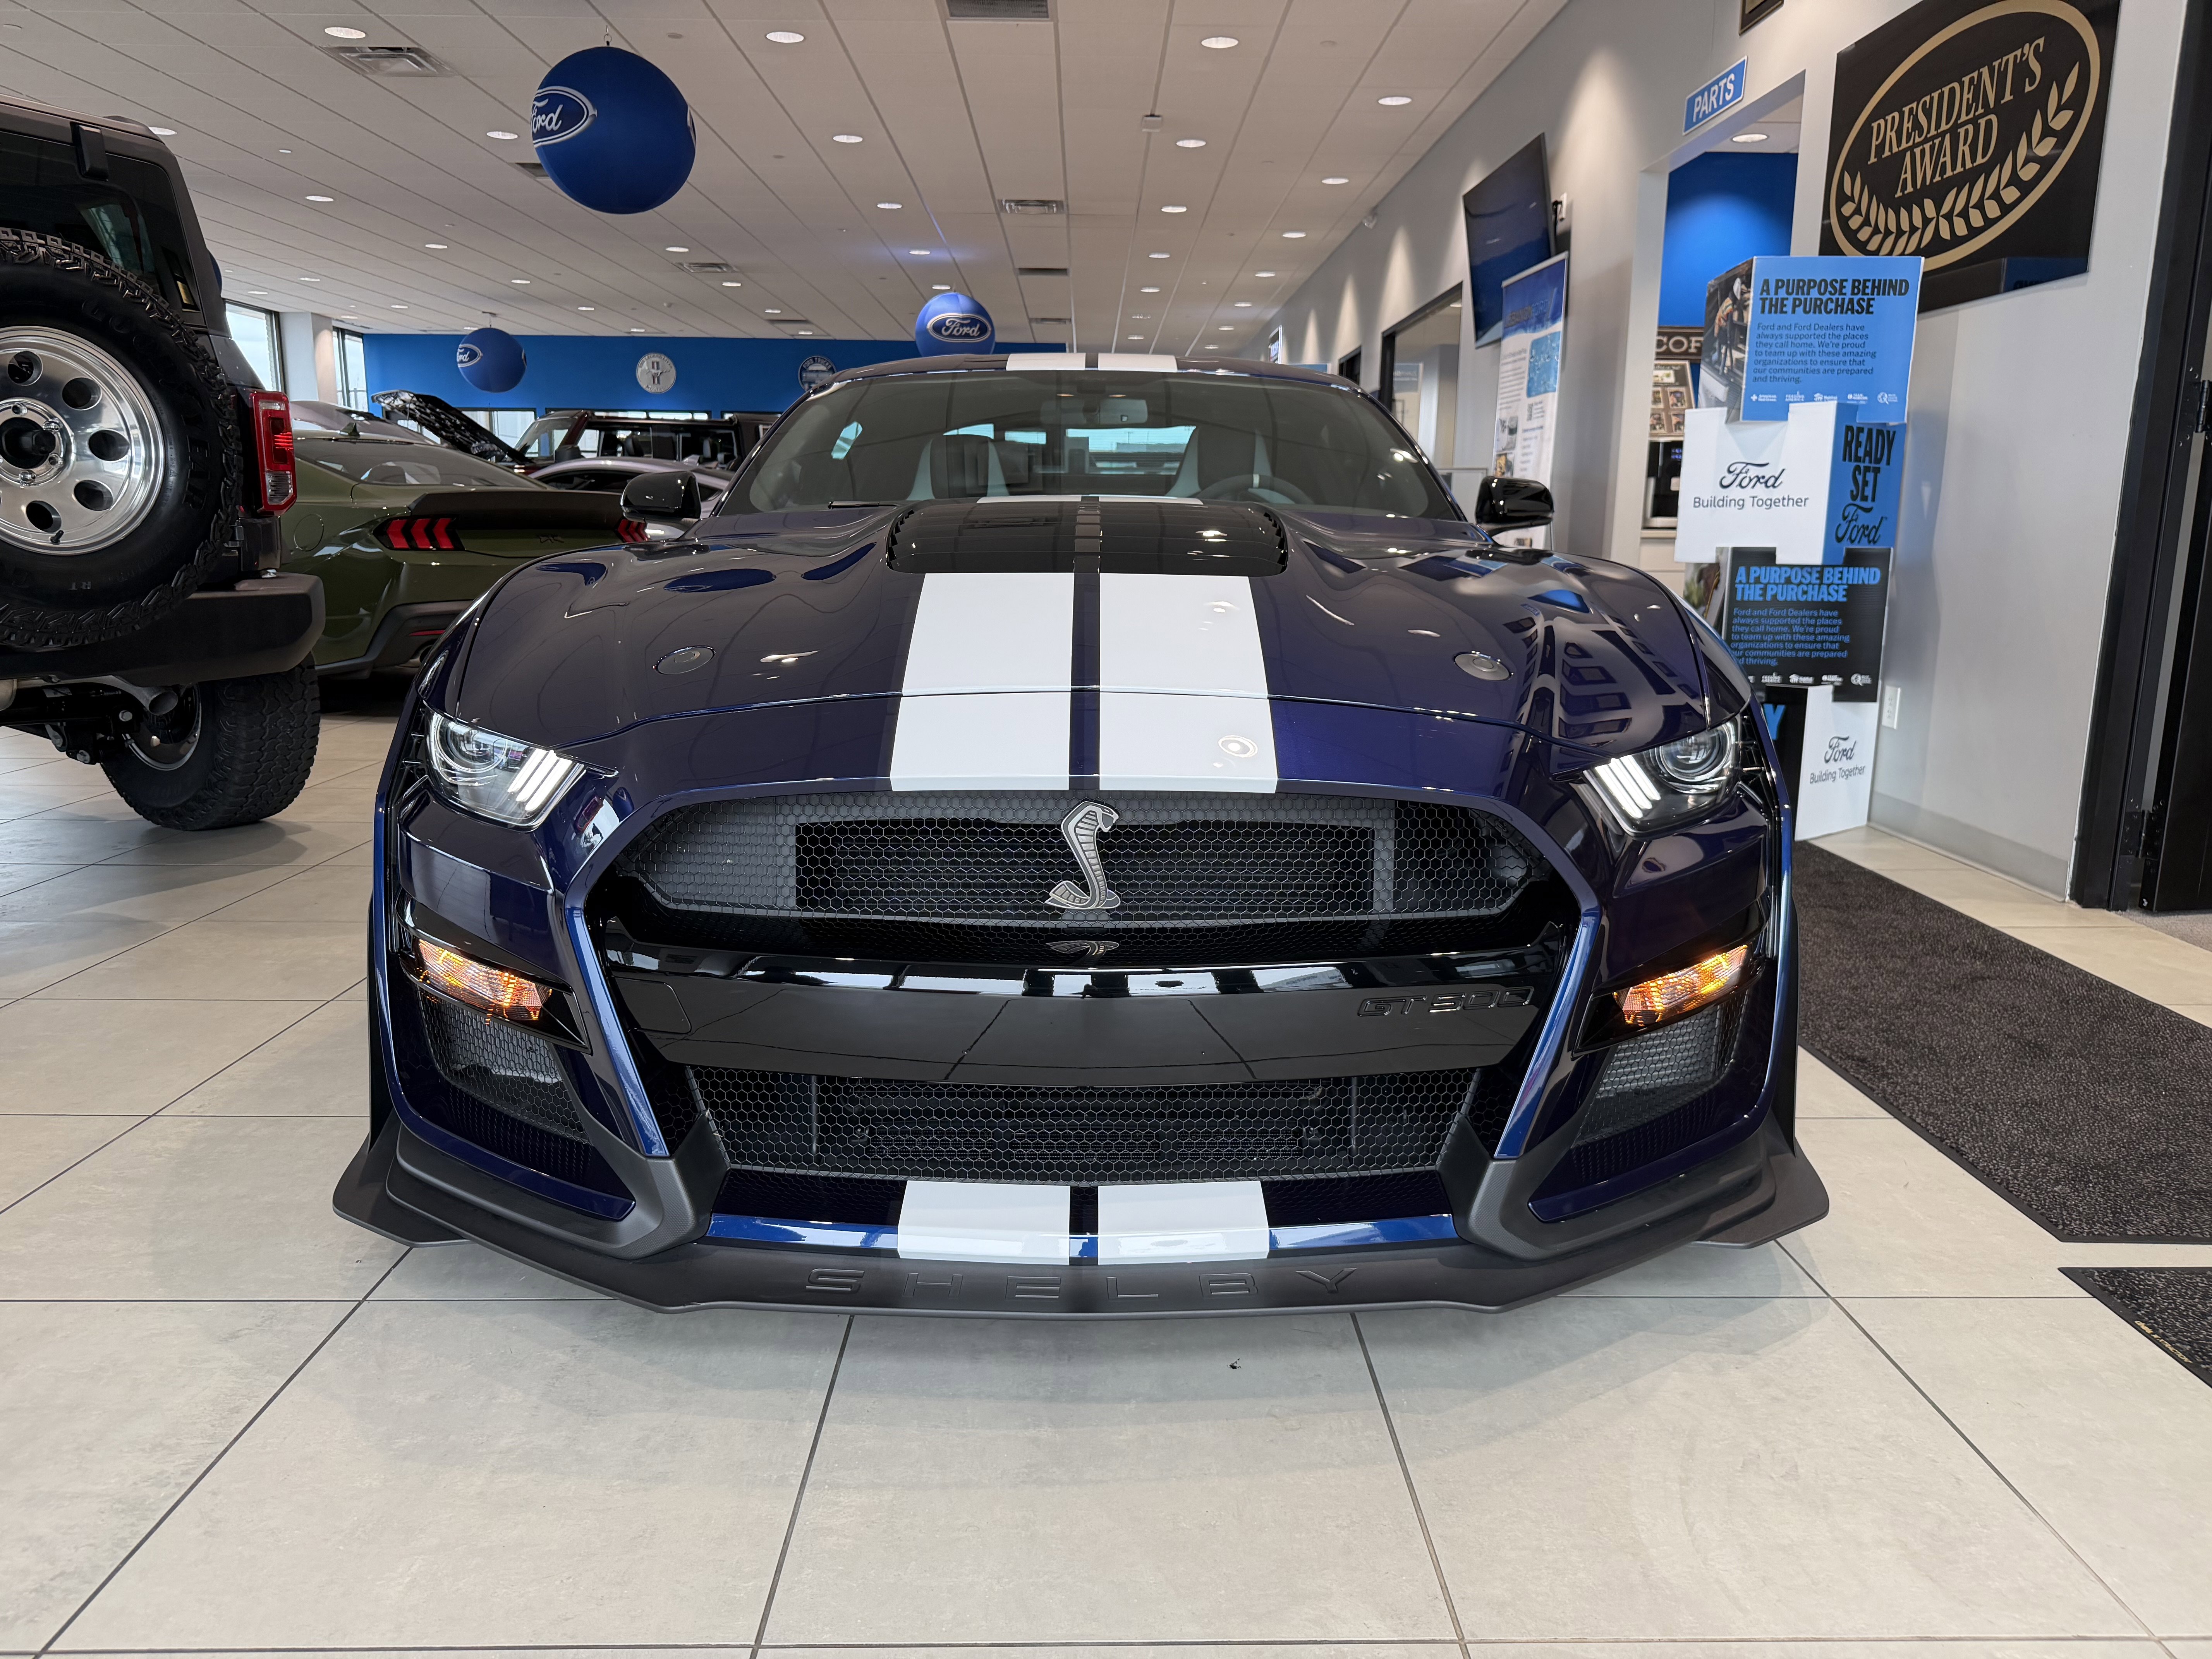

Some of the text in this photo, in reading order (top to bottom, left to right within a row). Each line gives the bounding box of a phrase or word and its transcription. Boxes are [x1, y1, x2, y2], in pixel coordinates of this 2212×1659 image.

[1693, 73, 1735, 122] PARTS
[1867, 36, 2045, 165] PRESIDENT'S
[1895, 114, 1998, 198] AWARD
[1759, 278, 1909, 296] A PURPOSE BEHIND
[1759, 297, 1875, 315] THE PURCHASE
[941, 318, 980, 337] Ford
[1756, 331, 1783, 340] always
[1814, 323, 1844, 331] Dealers
[1756, 341, 1773, 349] they
[1842, 341, 1865, 349] proud
[1842, 349, 1877, 359] amazing
[1754, 357, 1807, 366] organizations
[1837, 367, 1873, 375] prepared
[1842, 425, 1896, 465] READY
[1718, 461, 1786, 489] Ford
[1850, 465, 1881, 502] SET
[1693, 495, 1809, 510] Building Together
[1835, 503, 1883, 545] Ford
[1735, 566, 1881, 585] A PURPOSE BEHIND
[1735, 584, 1848, 602] THE PURCHASE
[1733, 608, 1751, 616] Ford
[1769, 608, 1786, 616] Ford
[1788, 608, 1818, 617] Dealers
[1733, 617, 1759, 625] always
[1817, 617, 1843, 625] places
[1815, 625, 1840, 634] proud
[1816, 634, 1850, 643] amazing
[1730, 641, 1783, 649] organizations
[1812, 650, 1848, 658] prepared
[1824, 735, 1857, 764] Ford
[1810, 764, 1866, 784] Building Together
[1357, 986, 1534, 1017] GT500
[805, 1267, 1357, 1300] SHELBY
